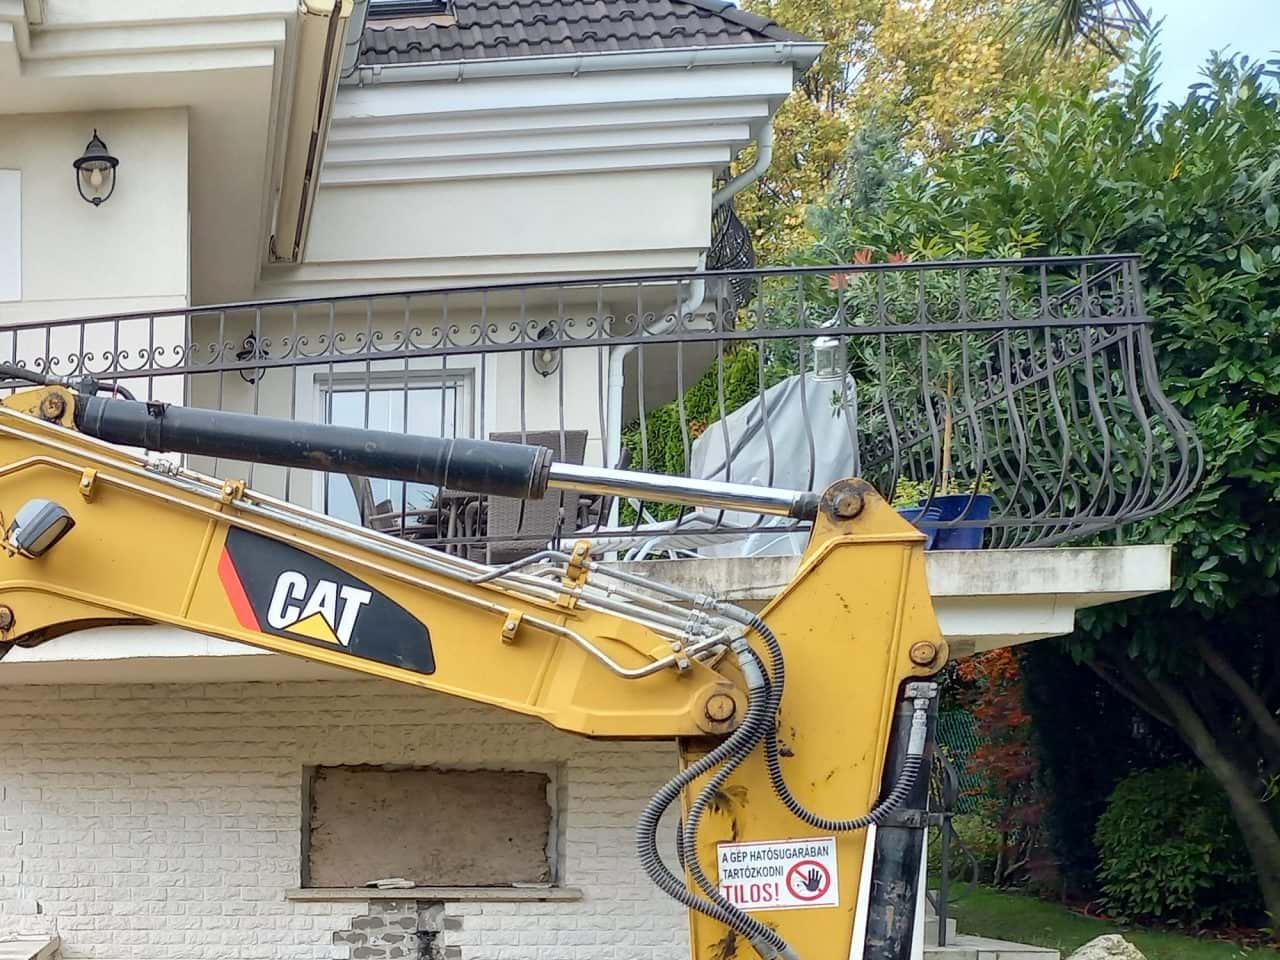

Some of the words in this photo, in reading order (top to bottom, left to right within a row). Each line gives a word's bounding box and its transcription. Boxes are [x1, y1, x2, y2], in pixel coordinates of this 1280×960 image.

[267, 571, 372, 647] CAT
[721, 852, 728, 863] A
[729, 849, 748, 863] GÉP
[749, 845, 829, 861] HATÓSUGARÁBAN
[723, 866, 784, 880] TARTÓZKODNI
[723, 882, 780, 903] TILOS!
